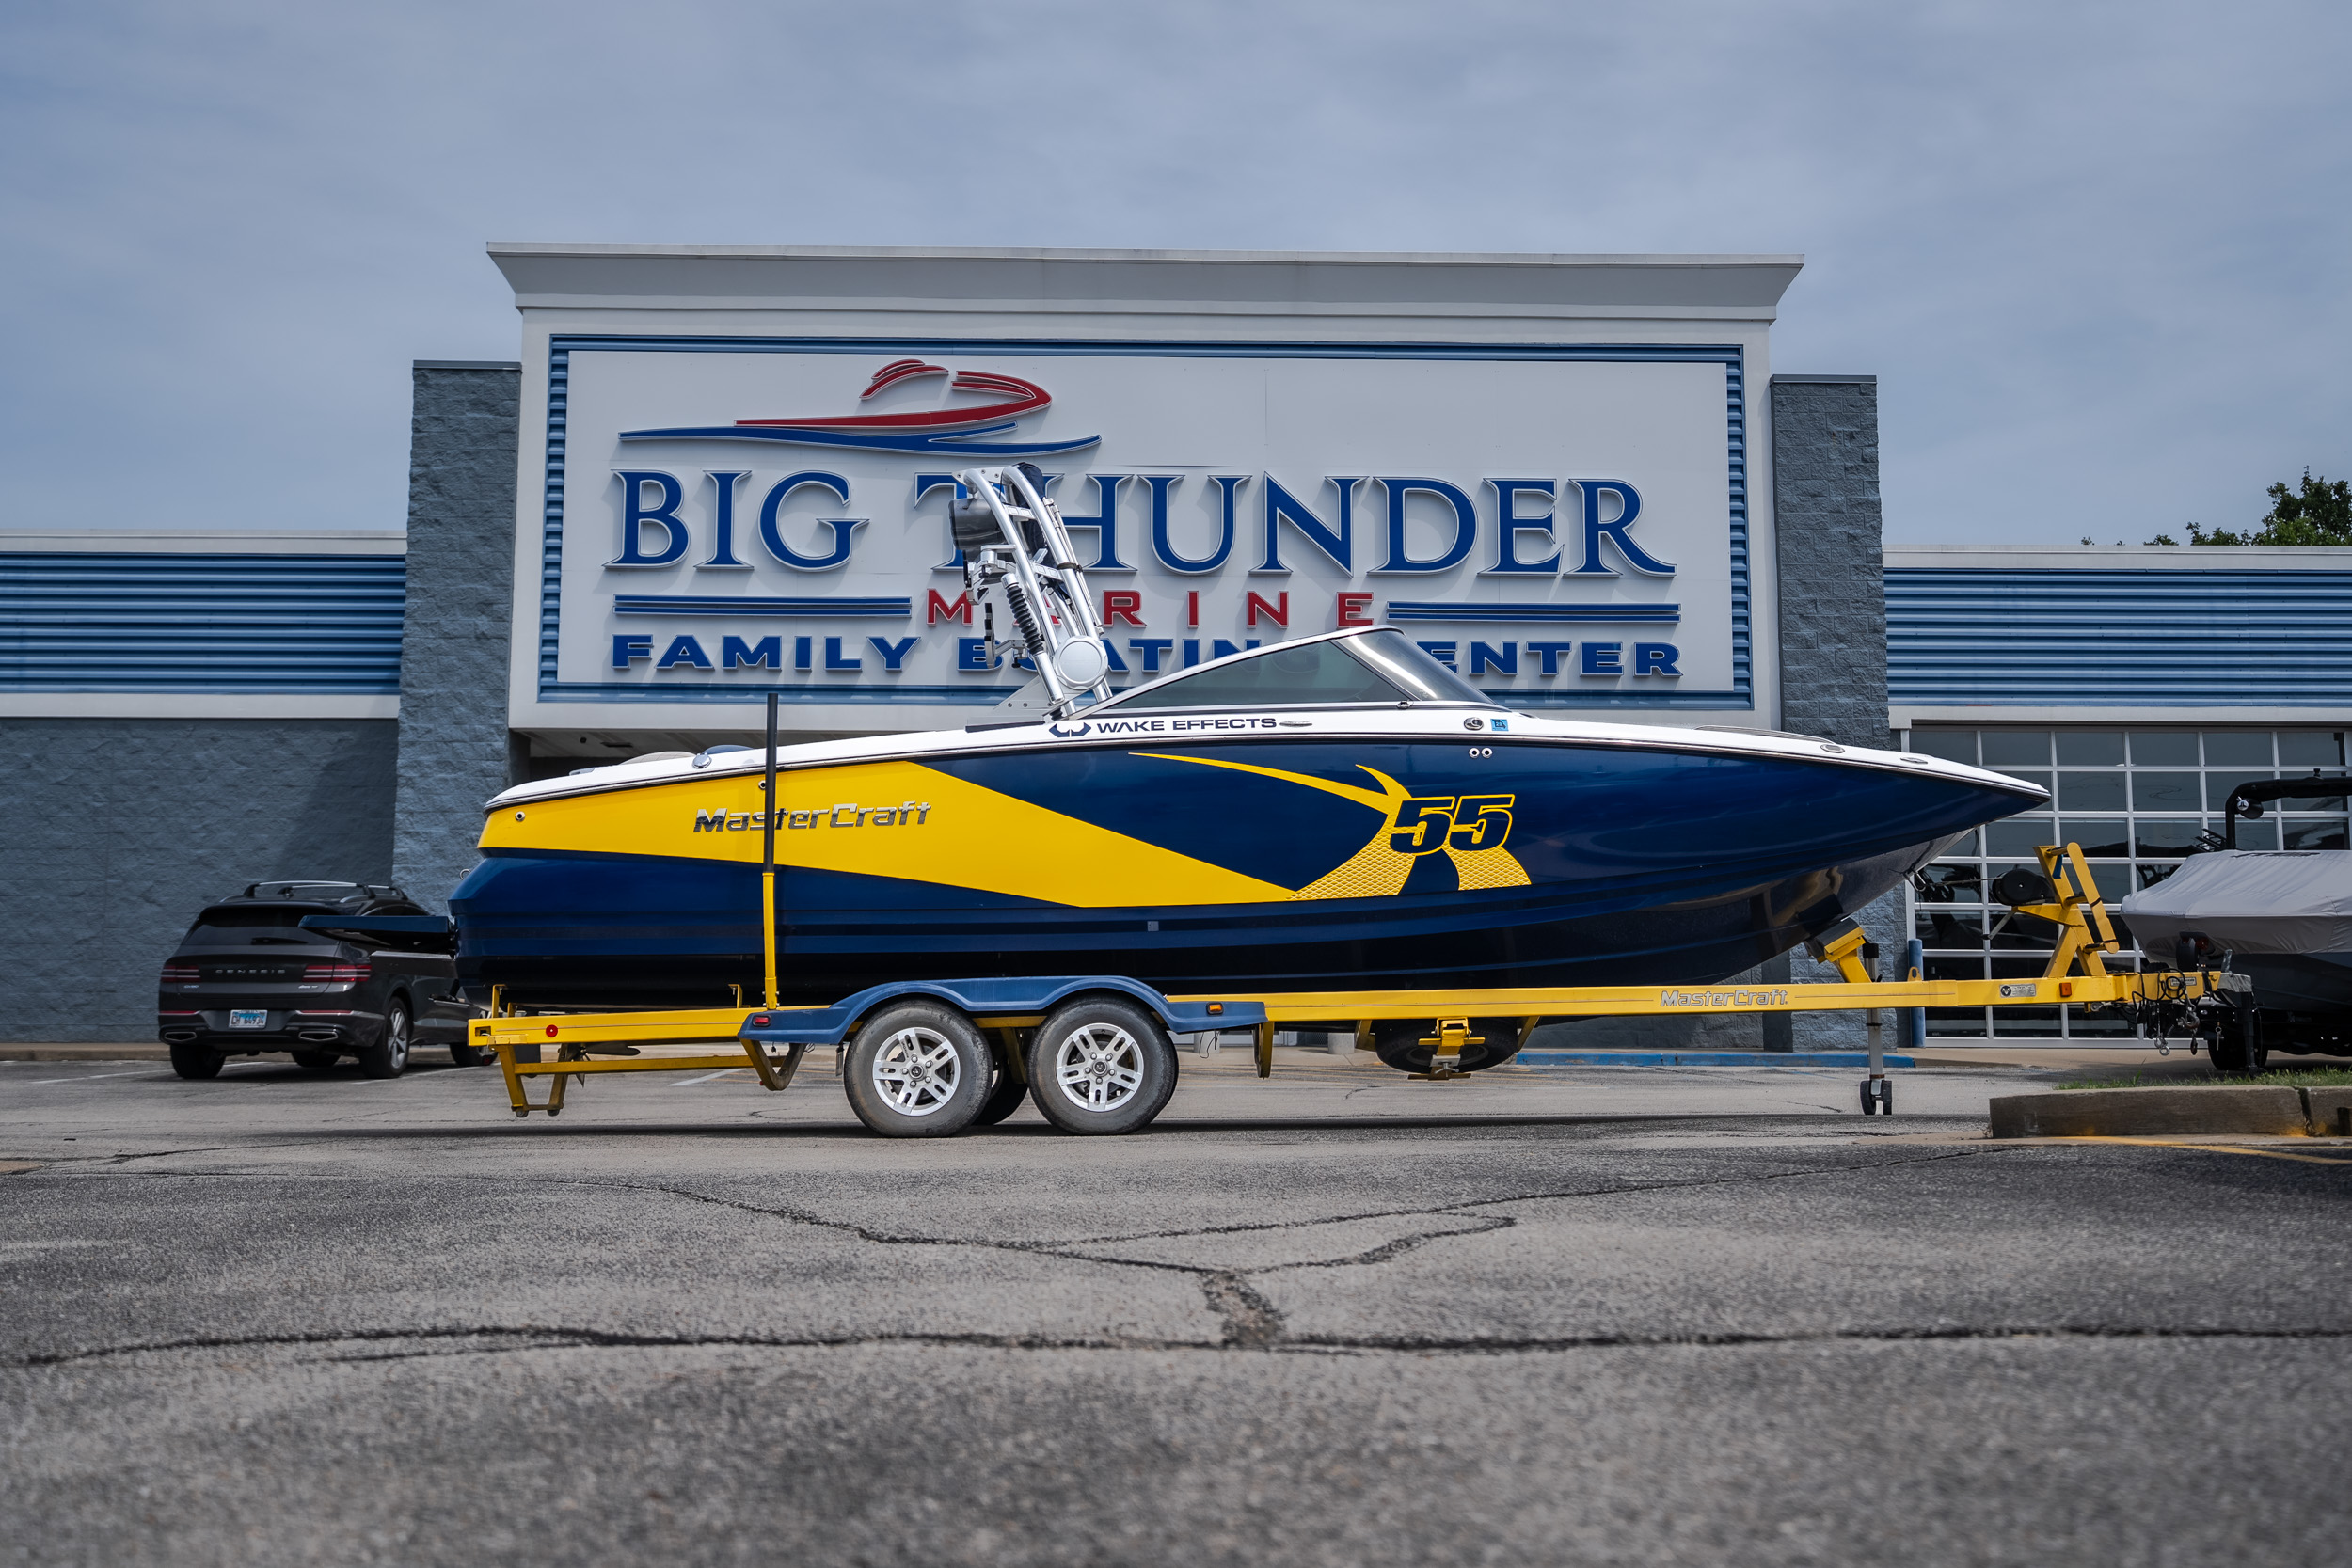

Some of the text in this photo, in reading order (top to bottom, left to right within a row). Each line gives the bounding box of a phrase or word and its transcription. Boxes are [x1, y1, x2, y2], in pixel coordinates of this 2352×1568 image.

[602, 468, 870, 572] BIG
[926, 588, 1375, 627] MRINE
[612, 635, 921, 671] FAMILY
[1415, 641, 1683, 677] ENTER
[1097, 718, 1278, 734] WAKE EFFECTS
[692, 800, 932, 833] MasterCraft
[1389, 794, 1516, 856] 55
[1660, 989, 1788, 1006] MasterCraft
